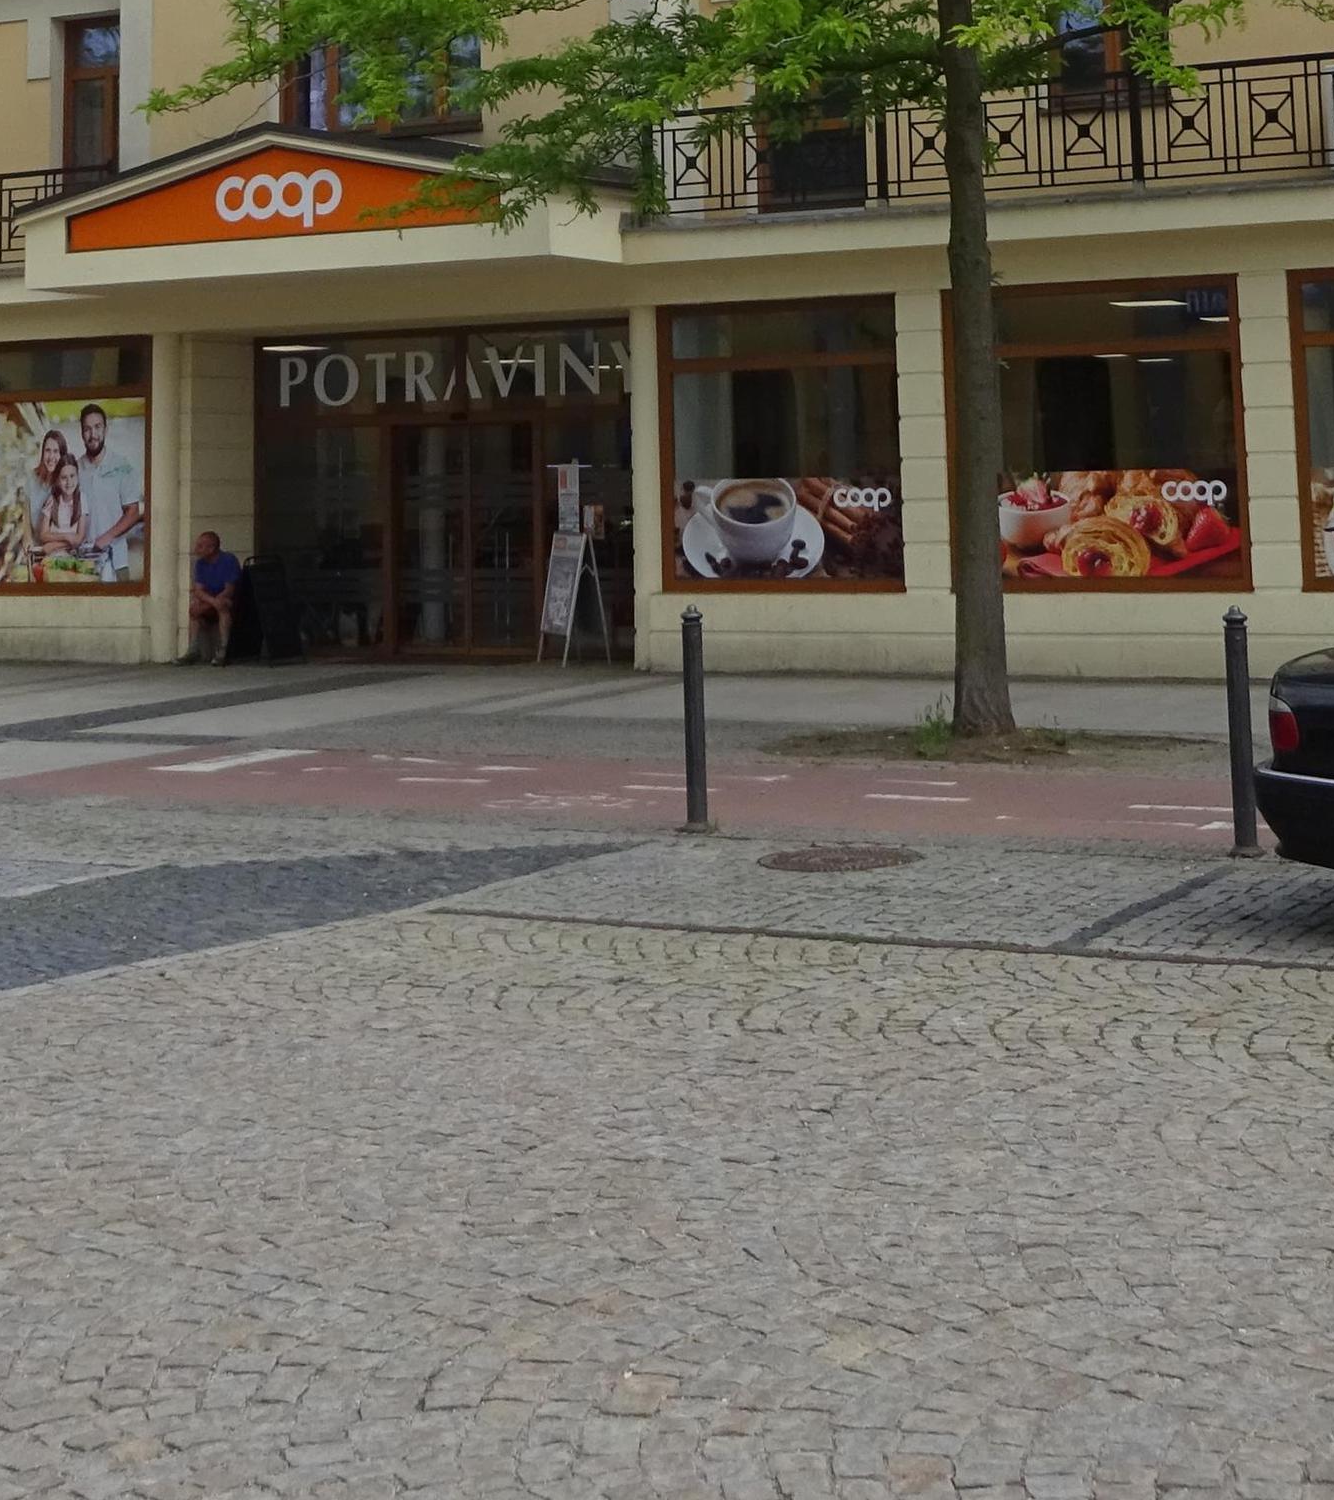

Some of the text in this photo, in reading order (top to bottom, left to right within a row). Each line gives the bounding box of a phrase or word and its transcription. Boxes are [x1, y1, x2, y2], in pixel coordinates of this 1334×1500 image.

[216, 169, 342, 227] coop
[833, 487, 892, 512] coop
[1161, 480, 1227, 505] coop
